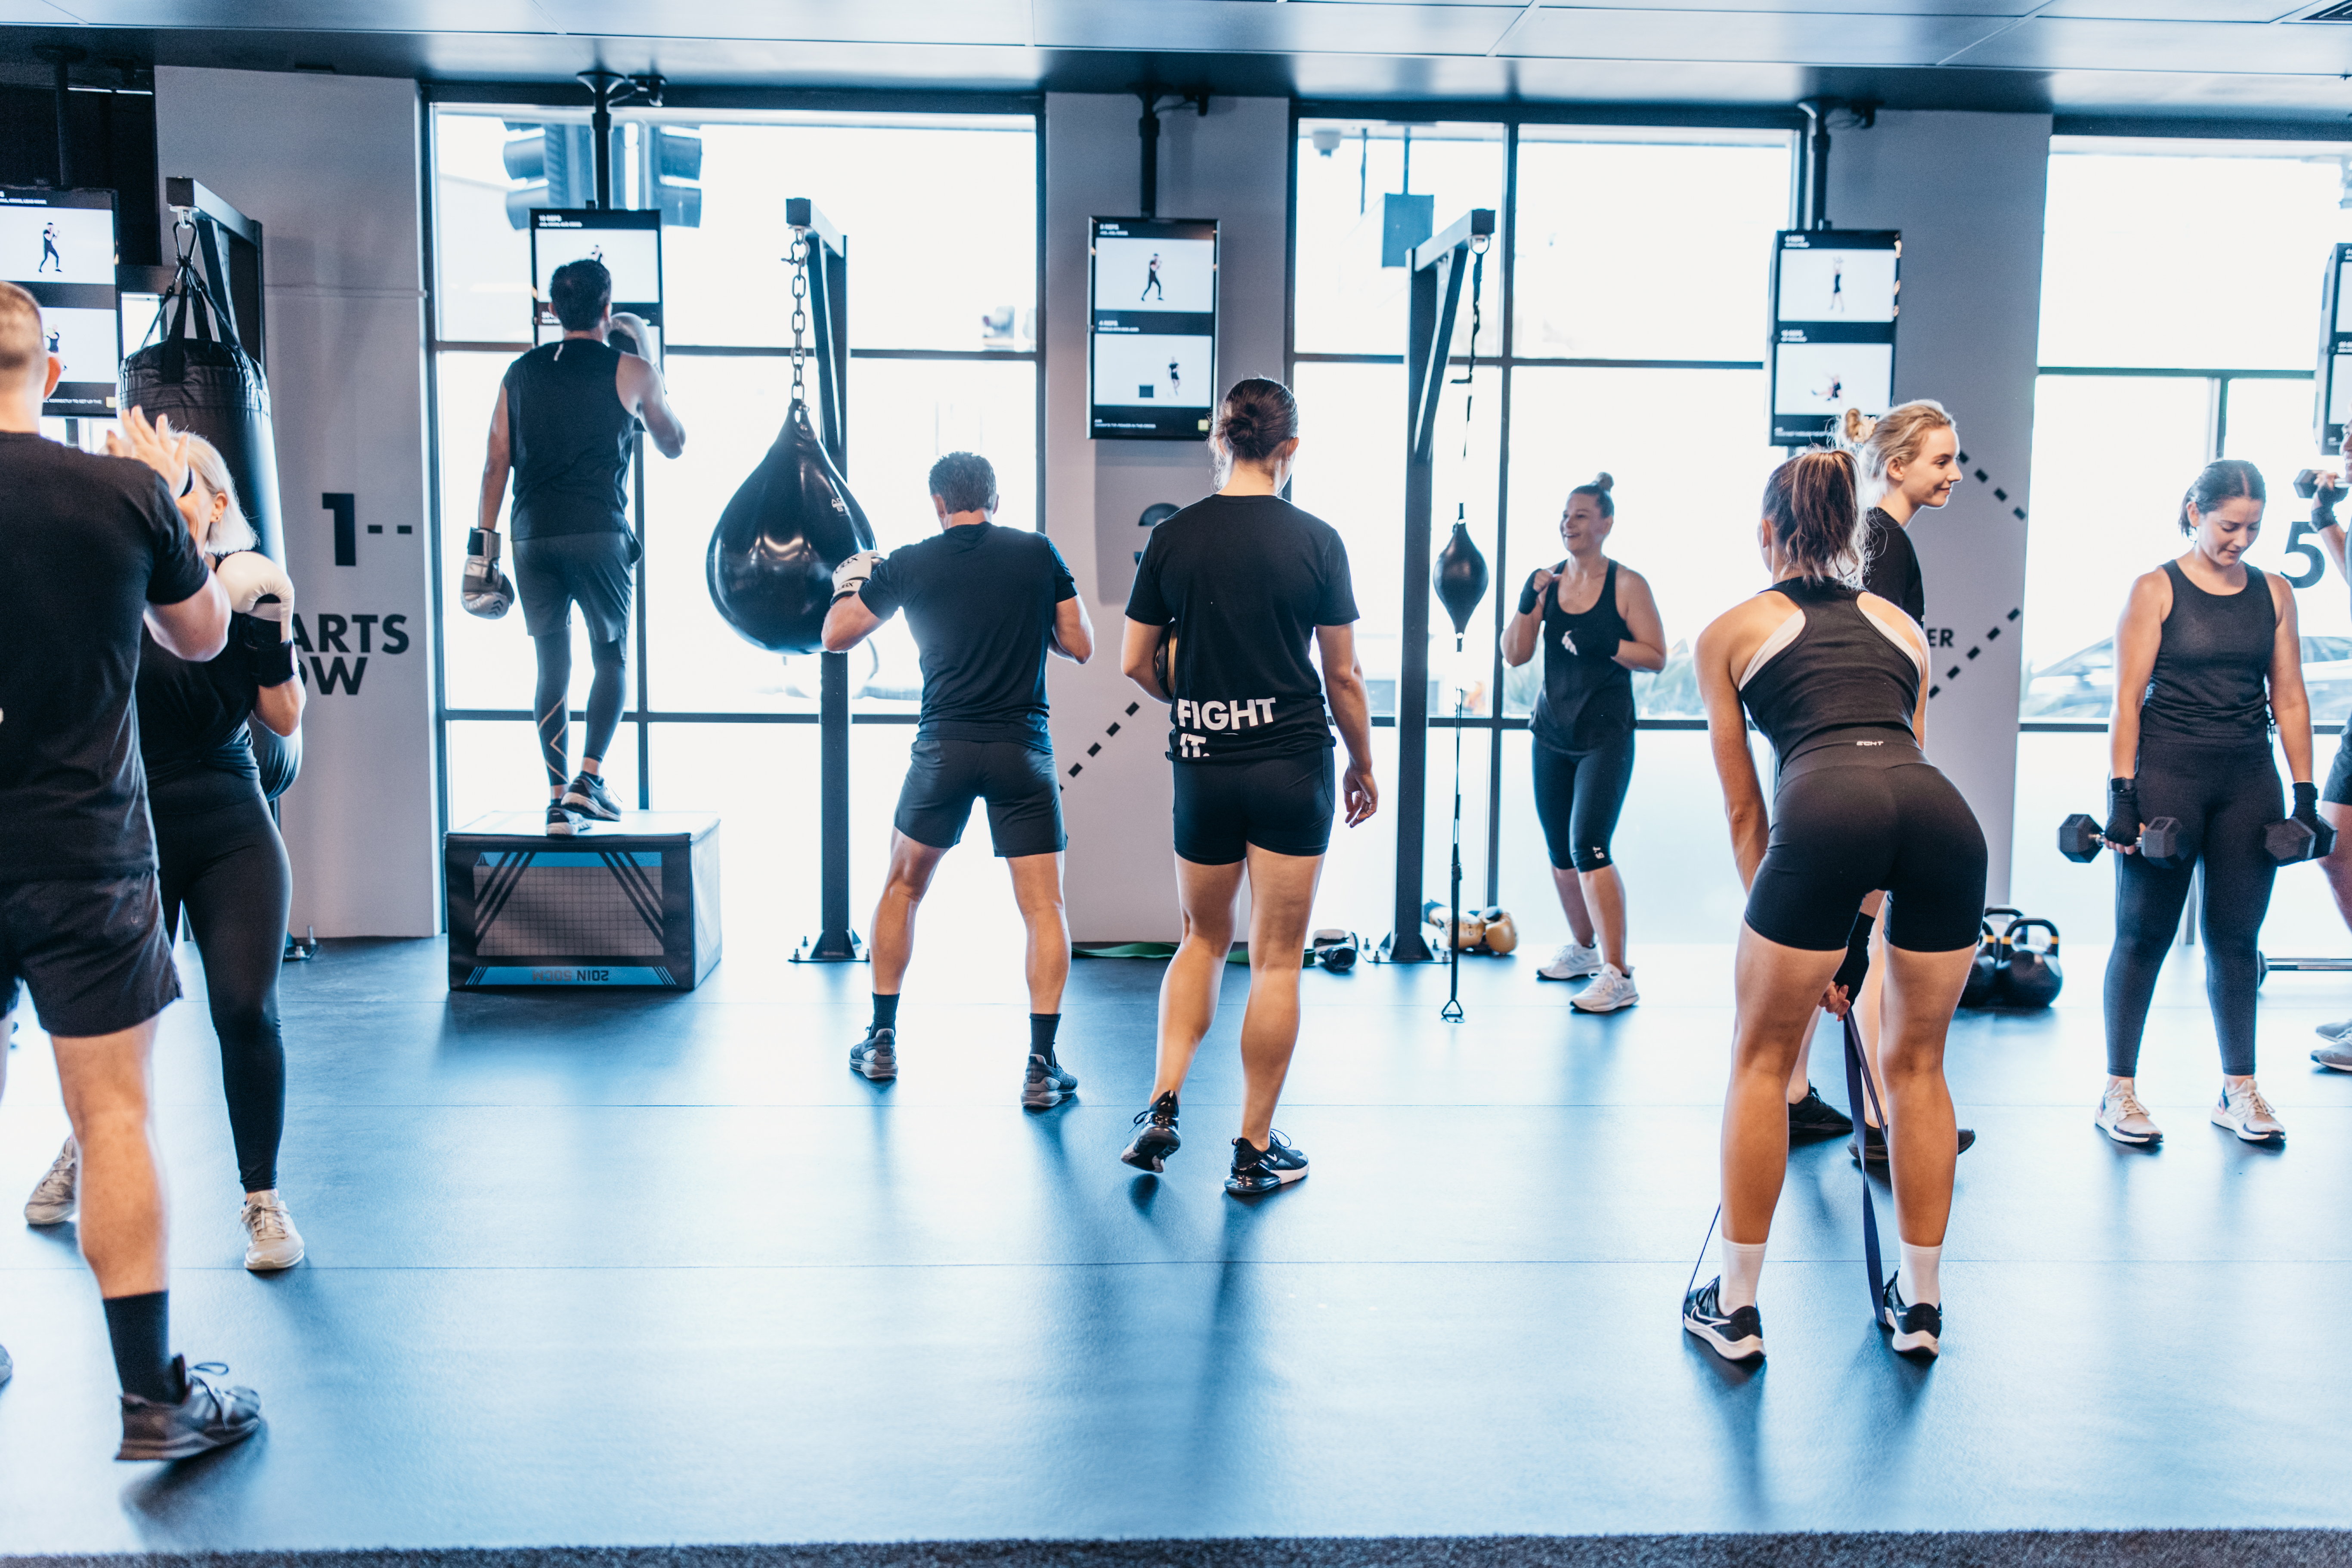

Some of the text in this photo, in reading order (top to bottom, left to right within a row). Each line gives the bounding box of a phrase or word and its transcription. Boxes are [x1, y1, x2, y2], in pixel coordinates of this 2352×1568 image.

[322, 493, 356, 566] 1
[2281, 522, 2325, 588] 5
[293, 613, 409, 654] ARTS
[1177, 697, 1276, 730] FIGHT
[532, 970, 609, 981] 20IN 50CM
